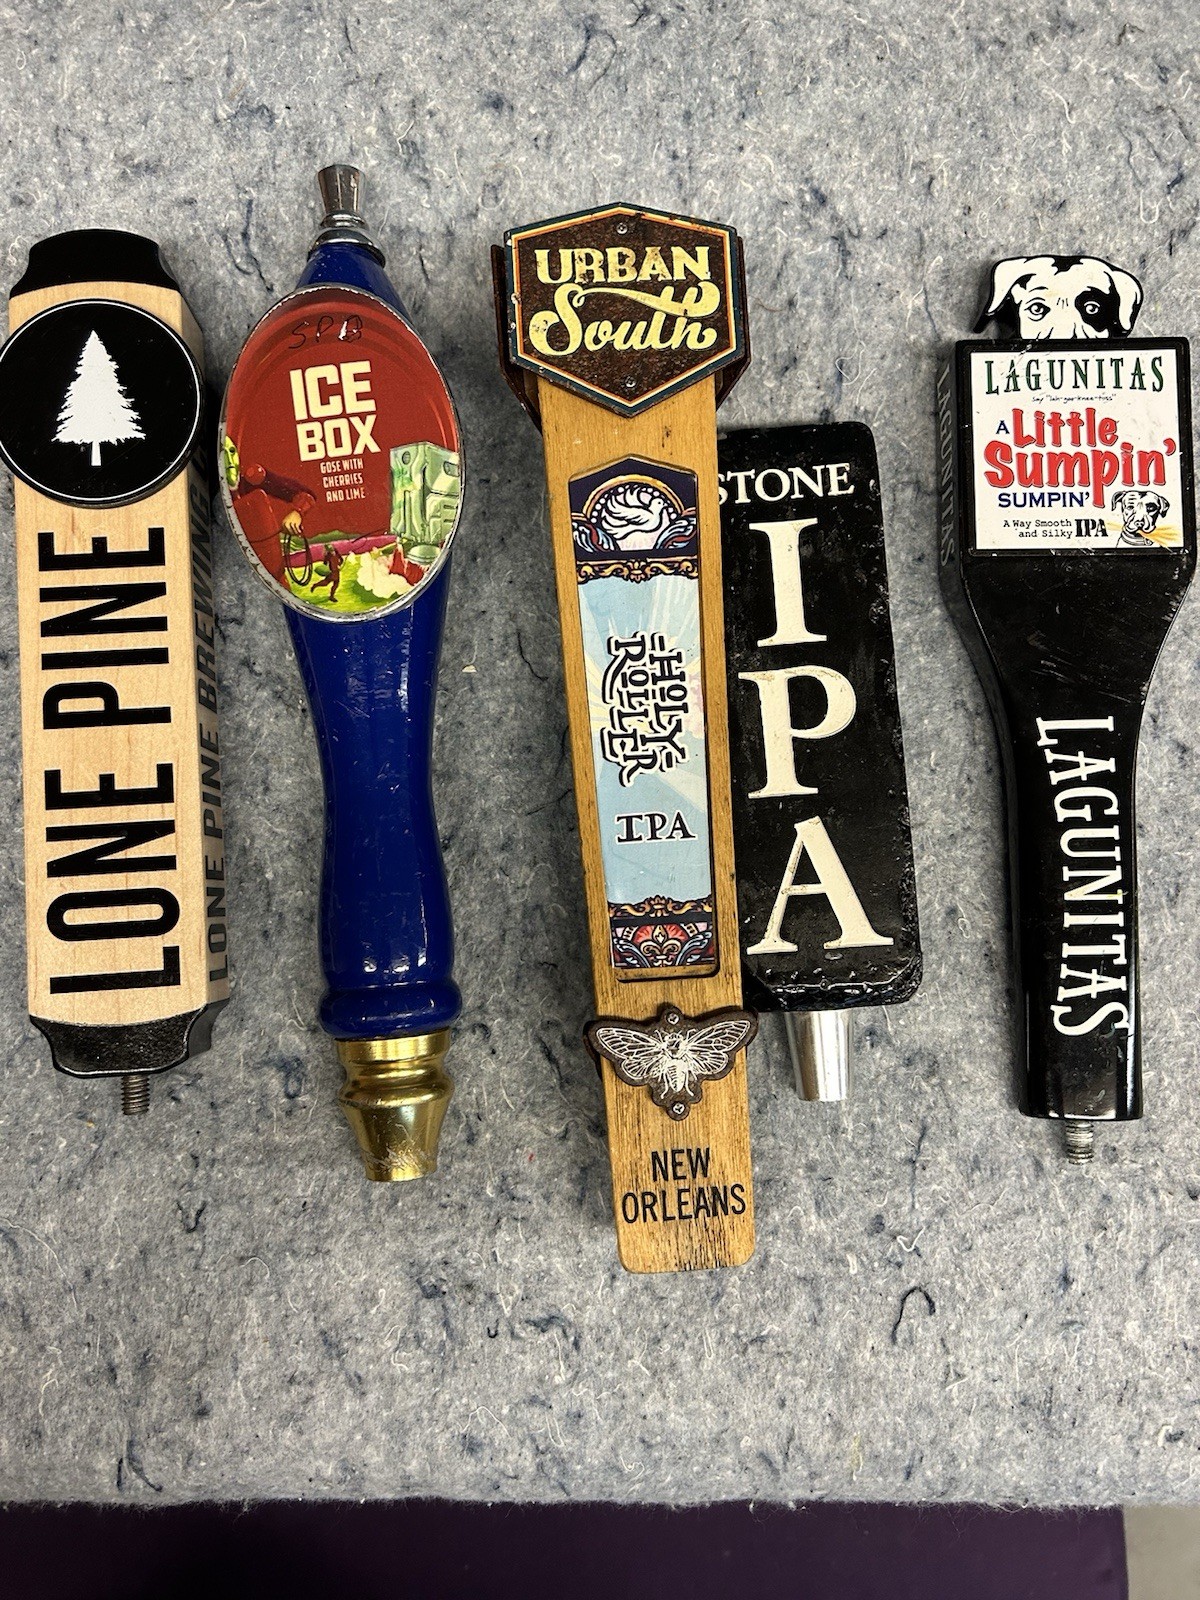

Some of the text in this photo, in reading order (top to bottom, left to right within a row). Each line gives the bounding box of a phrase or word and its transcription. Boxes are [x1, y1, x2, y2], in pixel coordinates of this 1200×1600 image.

[534, 246, 711, 284] URBAN
[529, 281, 720, 356] South
[290, 360, 376, 421] ICE
[984, 356, 1164, 395] LAGUNITAS
[296, 415, 381, 461] BOX
[996, 407, 1120, 448] A Little
[320, 458, 364, 474] GOSE WITH
[323, 473, 363, 488] CHERRIES
[983, 438, 1176, 508] Sumpin'
[326, 487, 366, 502] AND LIME
[998, 492, 1090, 508] SUMPIN'
[1012, 519, 1031, 529] Way
[1035, 519, 1072, 527] Smooth
[1042, 529, 1073, 539] Silky
[1075, 518, 1108, 537] IPA
[189, 482, 217, 714] BREWING
[600, 632, 659, 787] ROLLER
[38, 527, 181, 994] LONE PINE
[199, 723, 222, 839] PINE
[616, 811, 696, 842] IPA
[1036, 716, 1129, 1036] LAGUNITAS
[205, 855, 228, 982] LONE
[651, 1147, 710, 1182] NEW
[622, 1183, 746, 1224] ORLEANS
